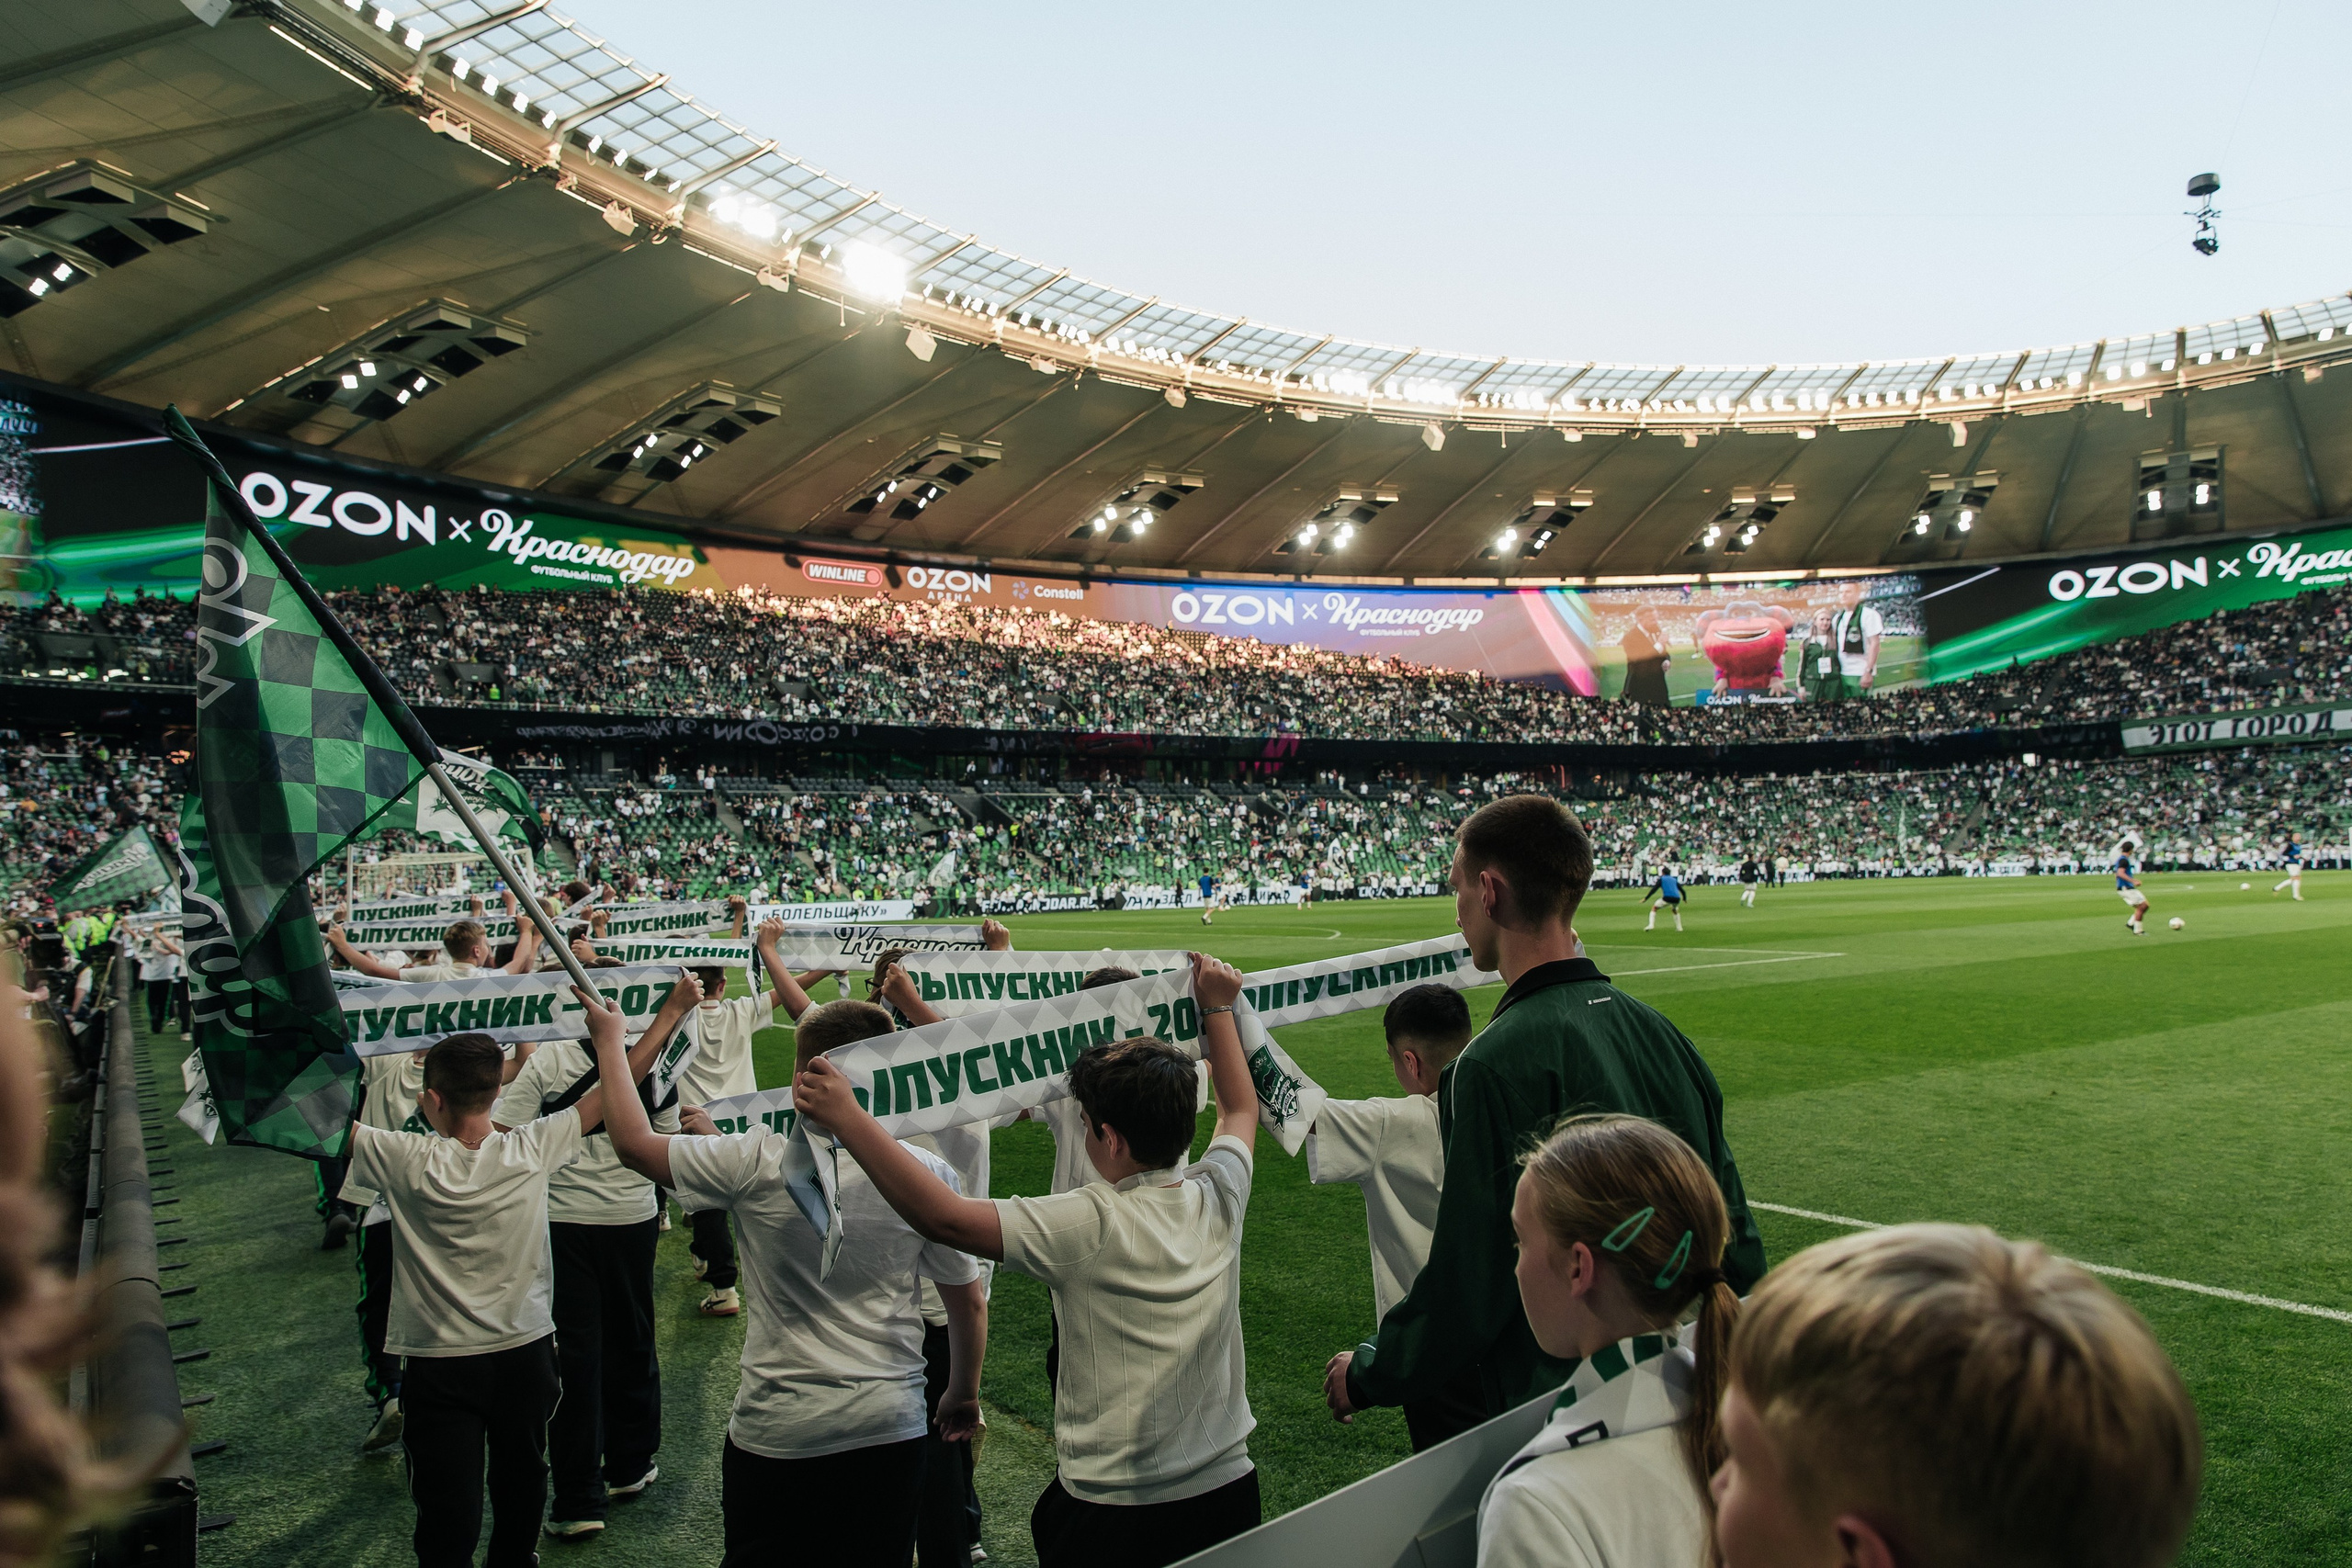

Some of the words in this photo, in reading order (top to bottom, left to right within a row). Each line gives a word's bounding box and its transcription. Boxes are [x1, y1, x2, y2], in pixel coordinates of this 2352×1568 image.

[239, 471, 436, 546] OZON
[480, 508, 695, 586] Краснодар
[530, 564, 590, 581] ФУТБОЛЬНЫЙ
[591, 572, 614, 584] КЛУБ
[808, 564, 865, 582] WINLINE
[907, 566, 991, 594] OZON
[2049, 556, 2209, 602] OZON
[1034, 585, 1084, 600] Constell
[1171, 592, 1294, 626] OZON
[1323, 592, 1484, 636] Краснодар
[2149, 720, 2217, 745] ЭТОТ
[2231, 709, 2335, 739] ГОРОД
[763, 906, 888, 920] «БОЛЕЛЬЩКУ»
